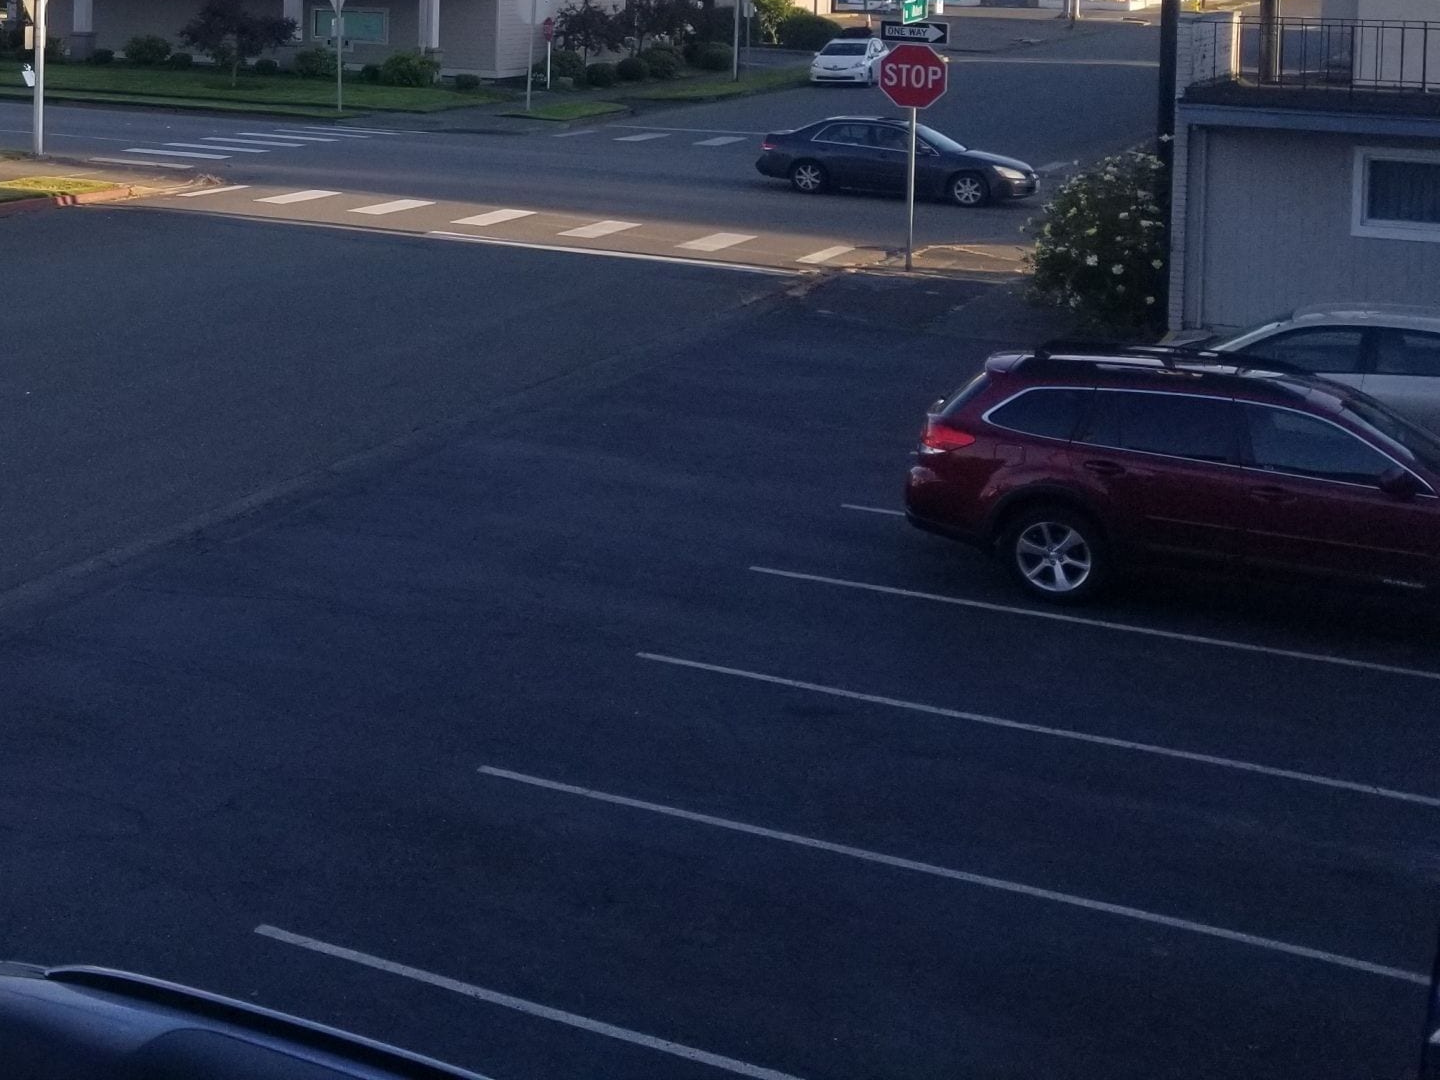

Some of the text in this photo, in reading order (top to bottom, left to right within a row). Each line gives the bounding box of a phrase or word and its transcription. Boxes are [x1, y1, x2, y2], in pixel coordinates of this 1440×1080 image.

[887, 26, 928, 37] ONE WAY
[884, 63, 942, 89] STOP
